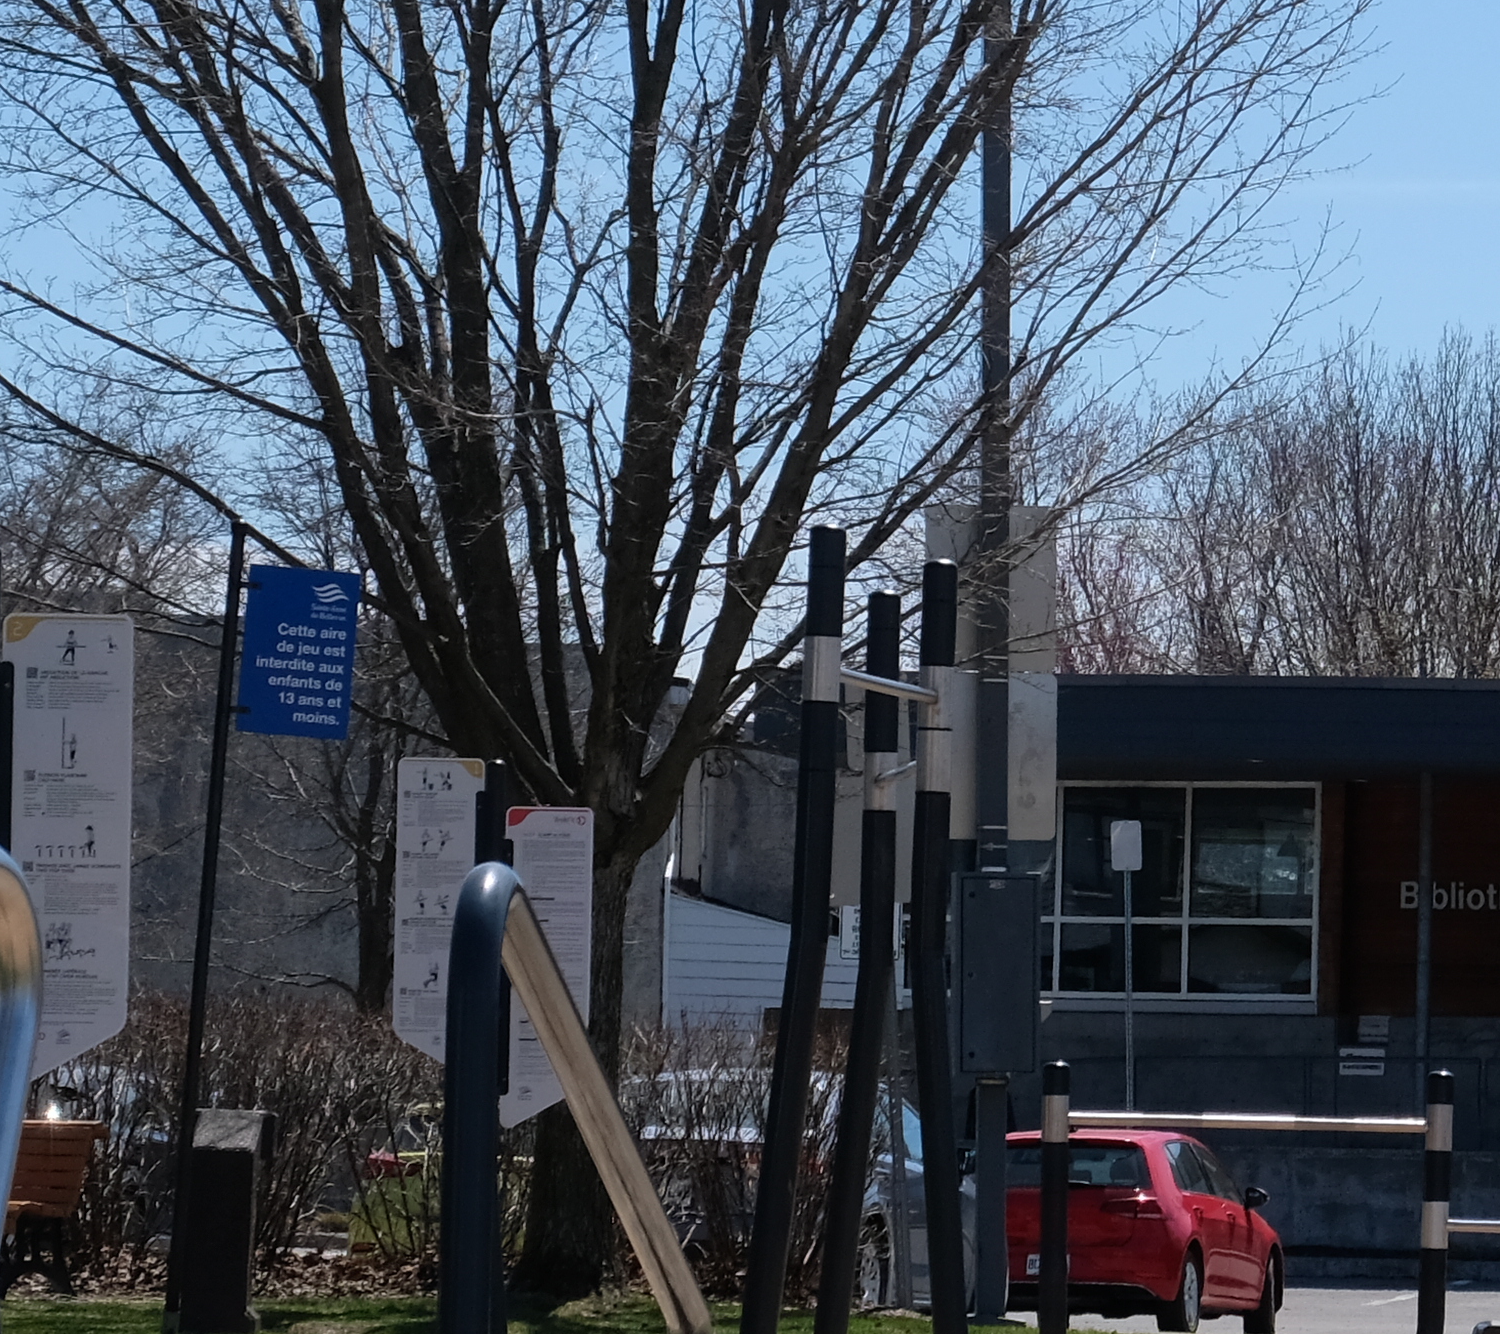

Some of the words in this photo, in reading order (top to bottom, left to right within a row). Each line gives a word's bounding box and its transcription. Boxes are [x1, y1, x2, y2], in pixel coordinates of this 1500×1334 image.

[277, 622, 316, 639] Cette
[320, 627, 347, 641] aire
[276, 640, 294, 653] de
[297, 641, 320, 656] jeu
[323, 645, 346, 657] est
[256, 655, 315, 672] interdite
[318, 663, 344, 675] aux
[268, 675, 321, 690] enfants
[325, 679, 343, 691] de
[278, 692, 295, 705] 13
[298, 696, 324, 708] ans
[327, 696, 342, 709] et
[292, 711, 340, 726] moins.
